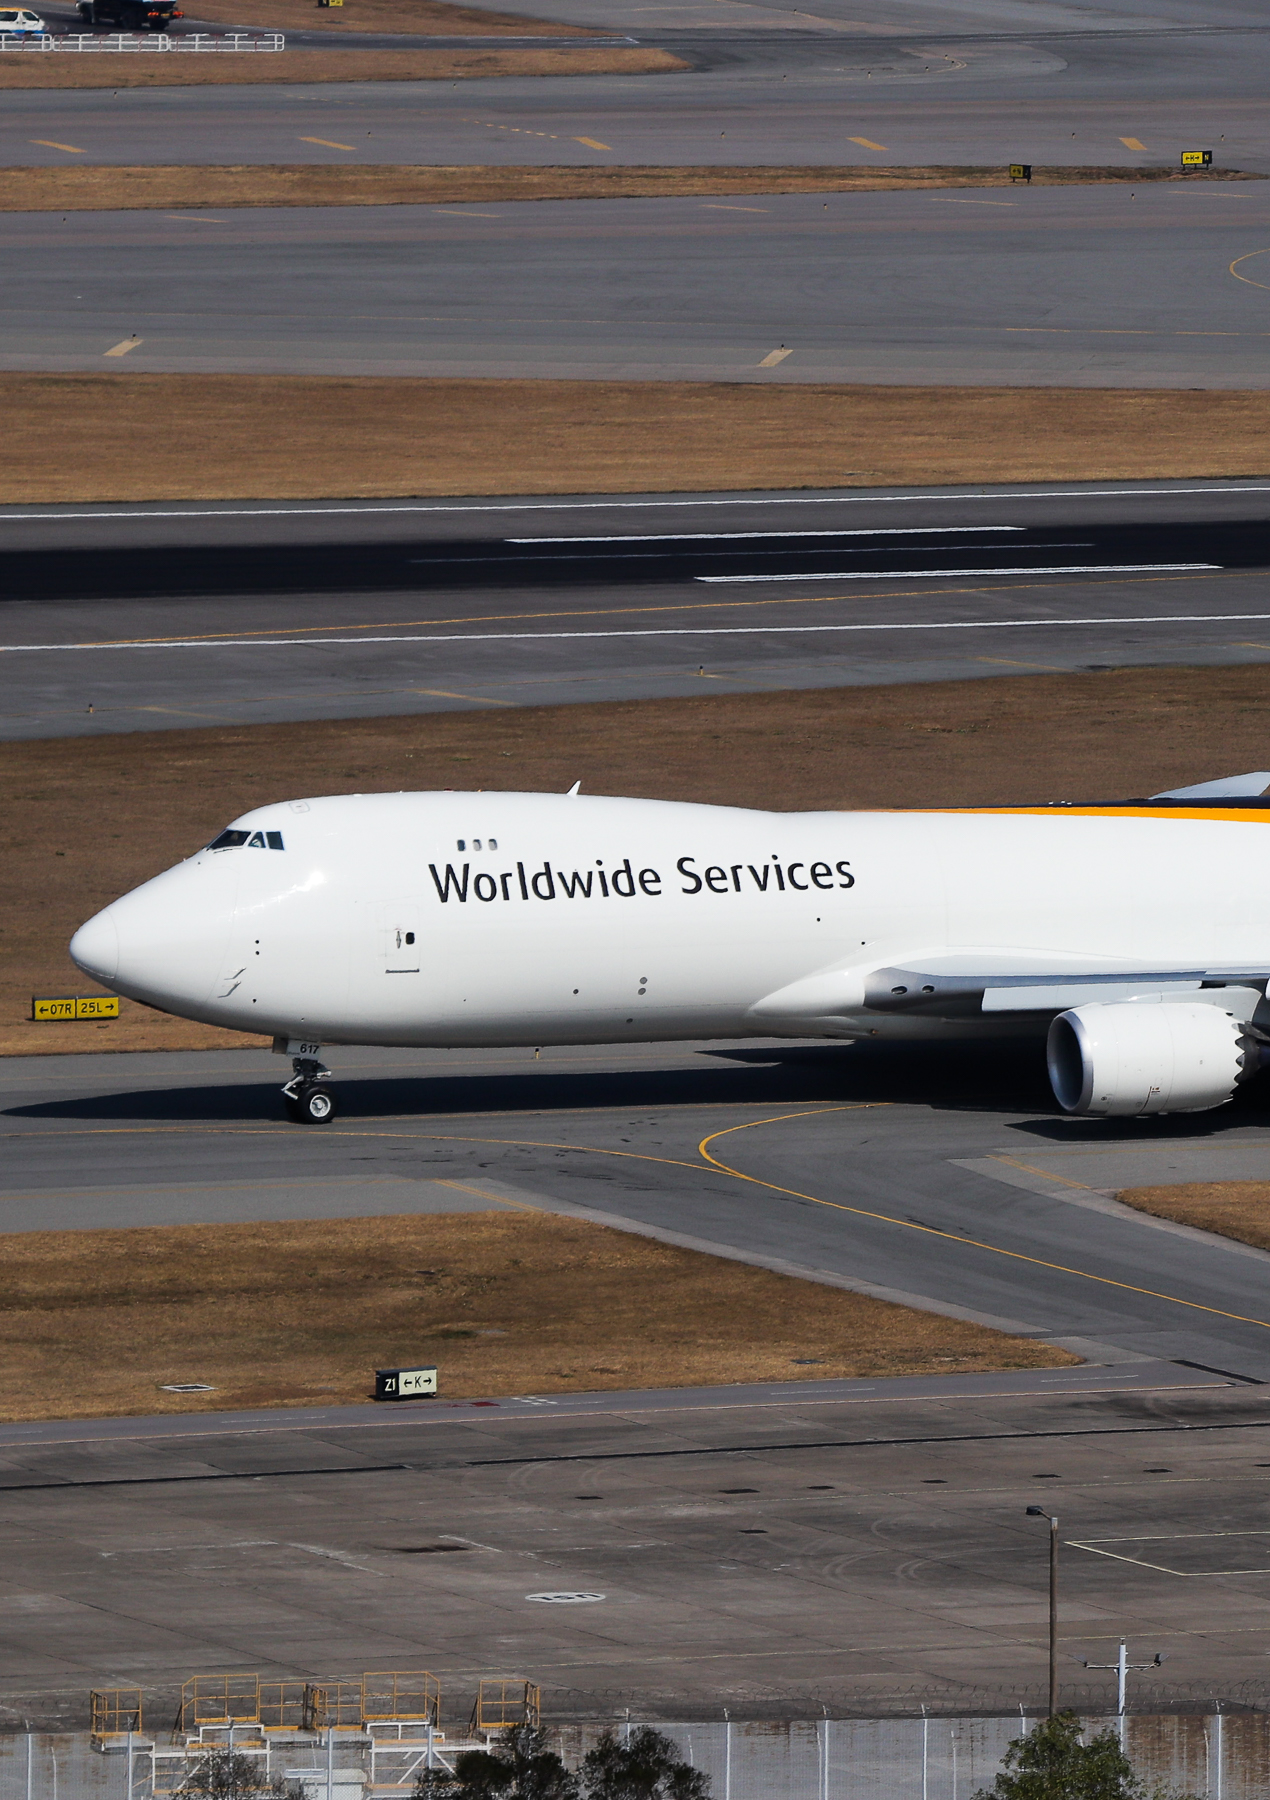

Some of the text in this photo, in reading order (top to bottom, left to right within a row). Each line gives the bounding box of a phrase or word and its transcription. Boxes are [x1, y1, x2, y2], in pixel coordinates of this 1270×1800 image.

[428, 854, 855, 903] Worldwide Services
[50, 1002, 103, 1015] 07R 25L
[300, 1043, 319, 1054] 617
[384, 1376, 421, 1392] Z1 K
